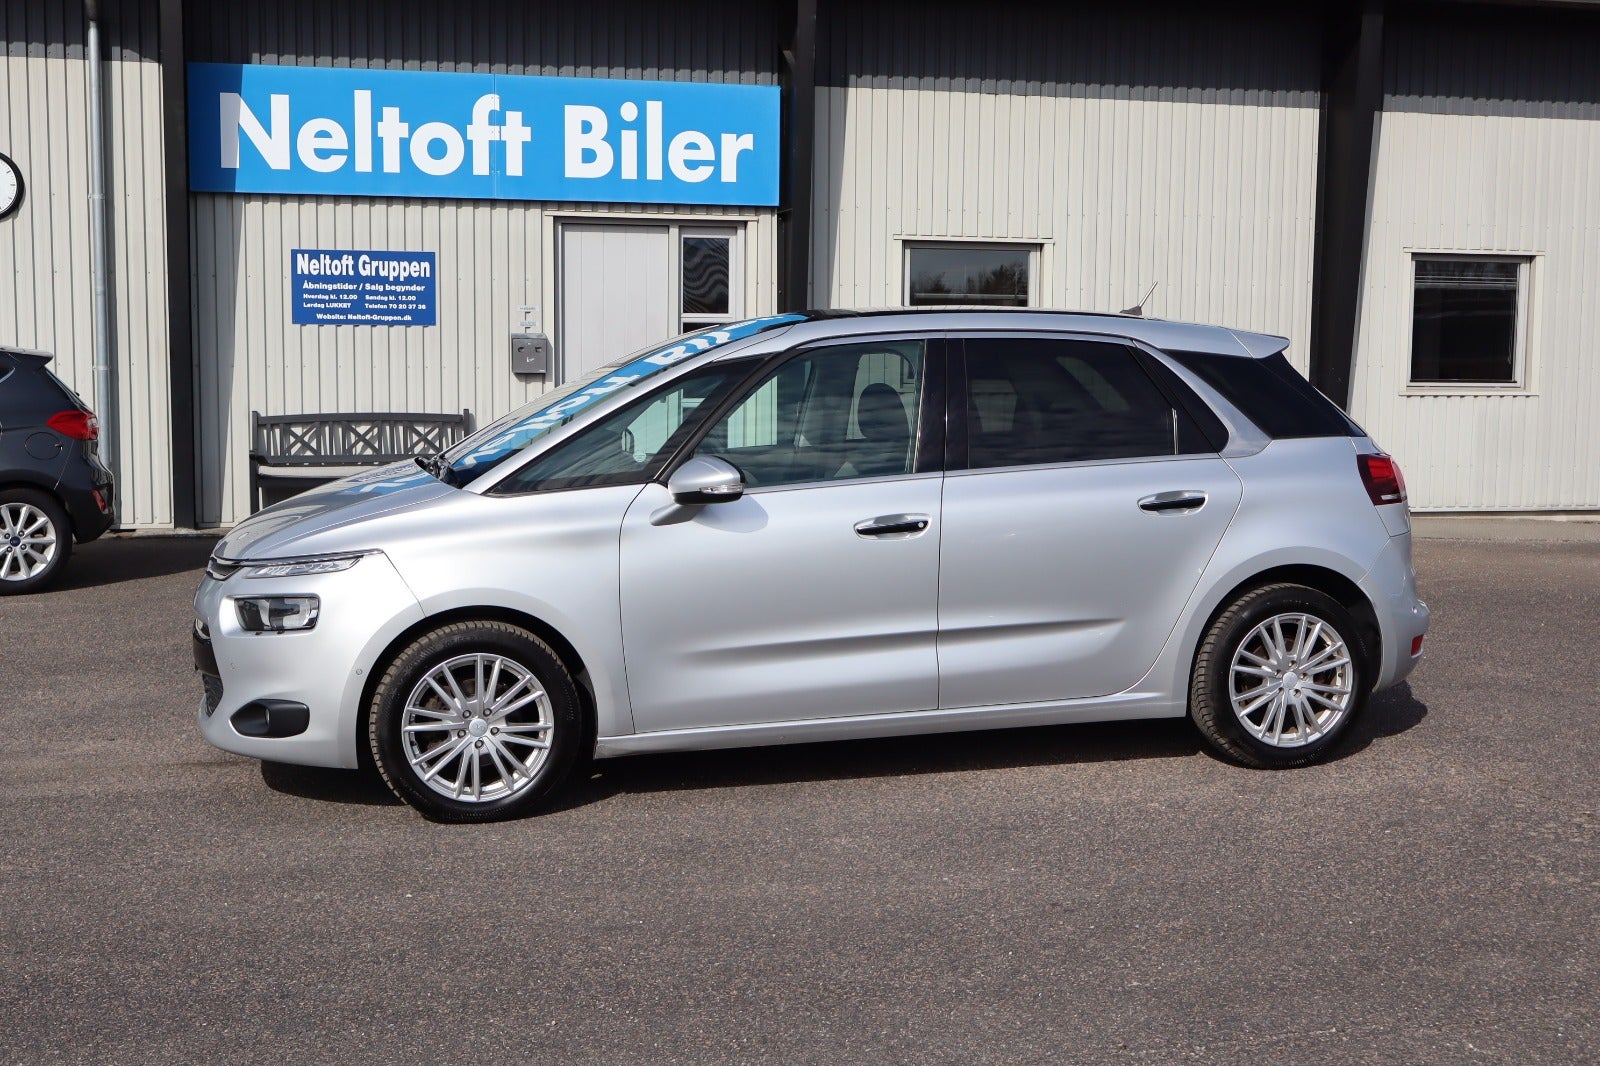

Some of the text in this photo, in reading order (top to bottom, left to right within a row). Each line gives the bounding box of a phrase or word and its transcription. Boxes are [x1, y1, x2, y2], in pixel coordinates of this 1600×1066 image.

[220, 90, 754, 183] Neltoft Biler
[297, 253, 431, 281] Neltoft Gruppen
[303, 280, 426, 292] Åbningstider / Salg begynder
[347, 314, 412, 322] Neltoft-Gruppen.dk
